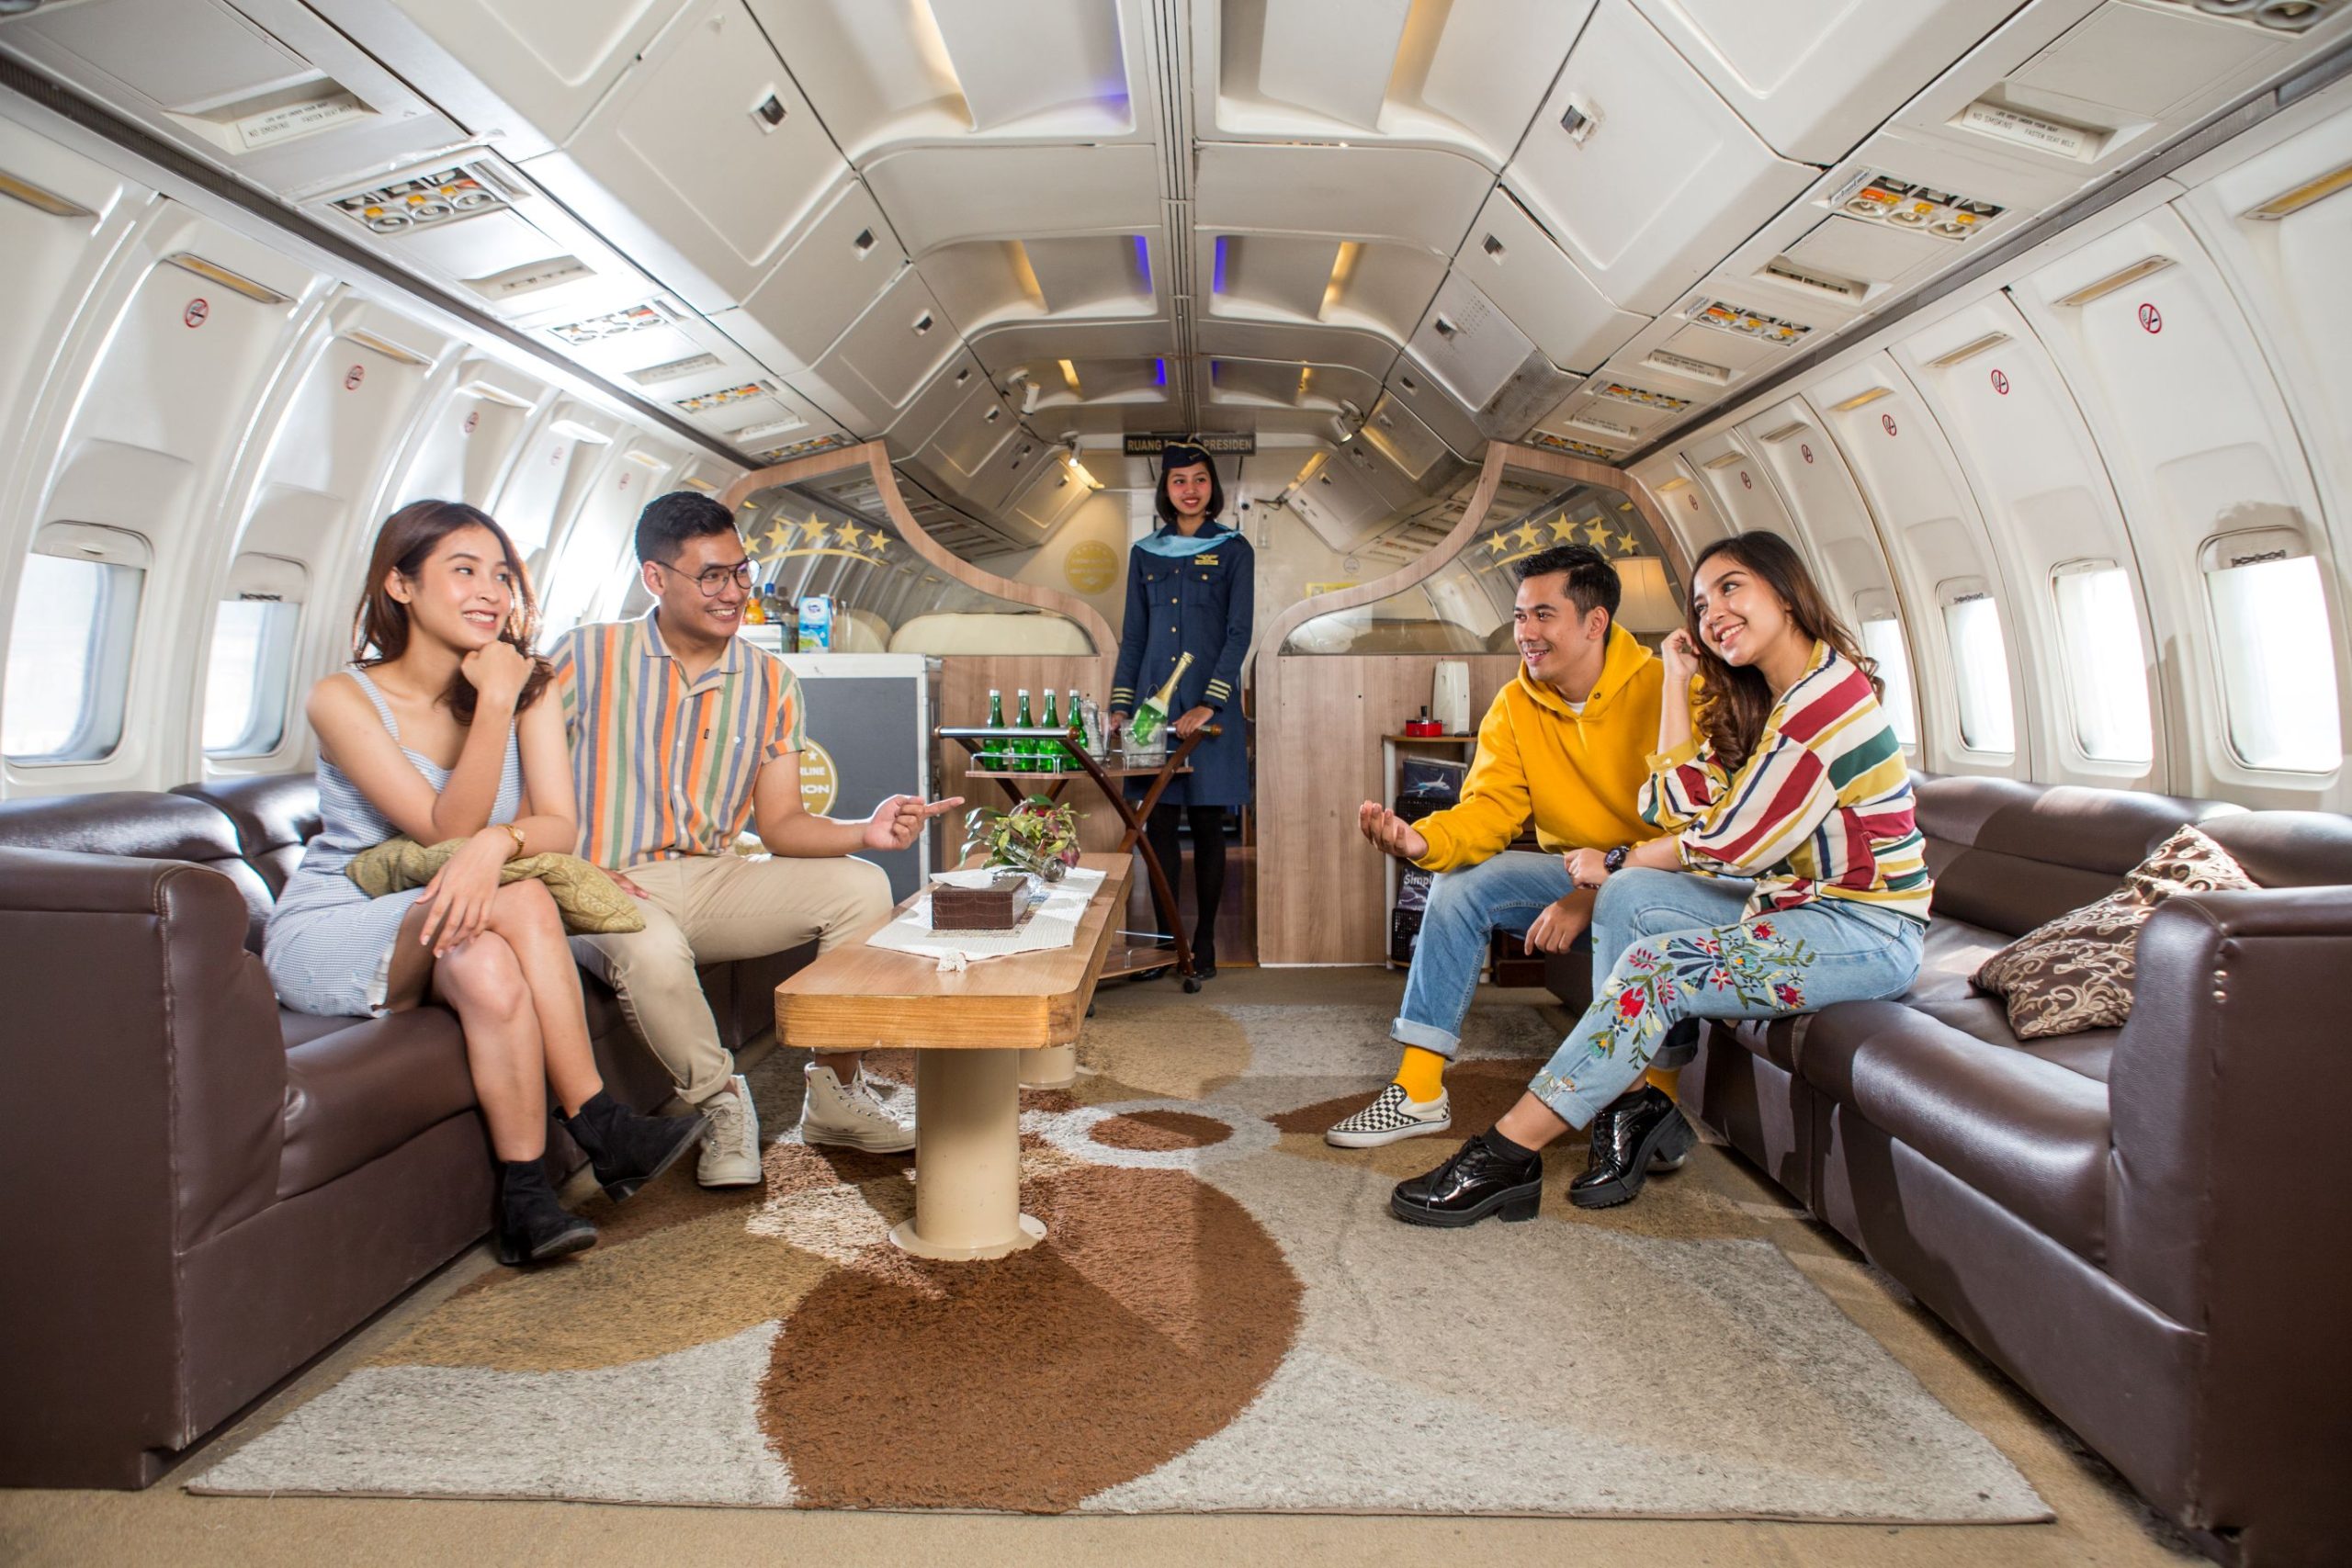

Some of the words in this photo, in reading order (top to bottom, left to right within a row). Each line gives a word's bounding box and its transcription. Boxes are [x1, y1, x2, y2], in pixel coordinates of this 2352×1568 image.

[1973, 112, 1982, 120] NO
[1984, 115, 2013, 130] SMOKING
[1127, 440, 1161, 450] RUANG
[1204, 440, 1252, 450] PRESIDEN
[1403, 872, 1434, 886] Simpl
